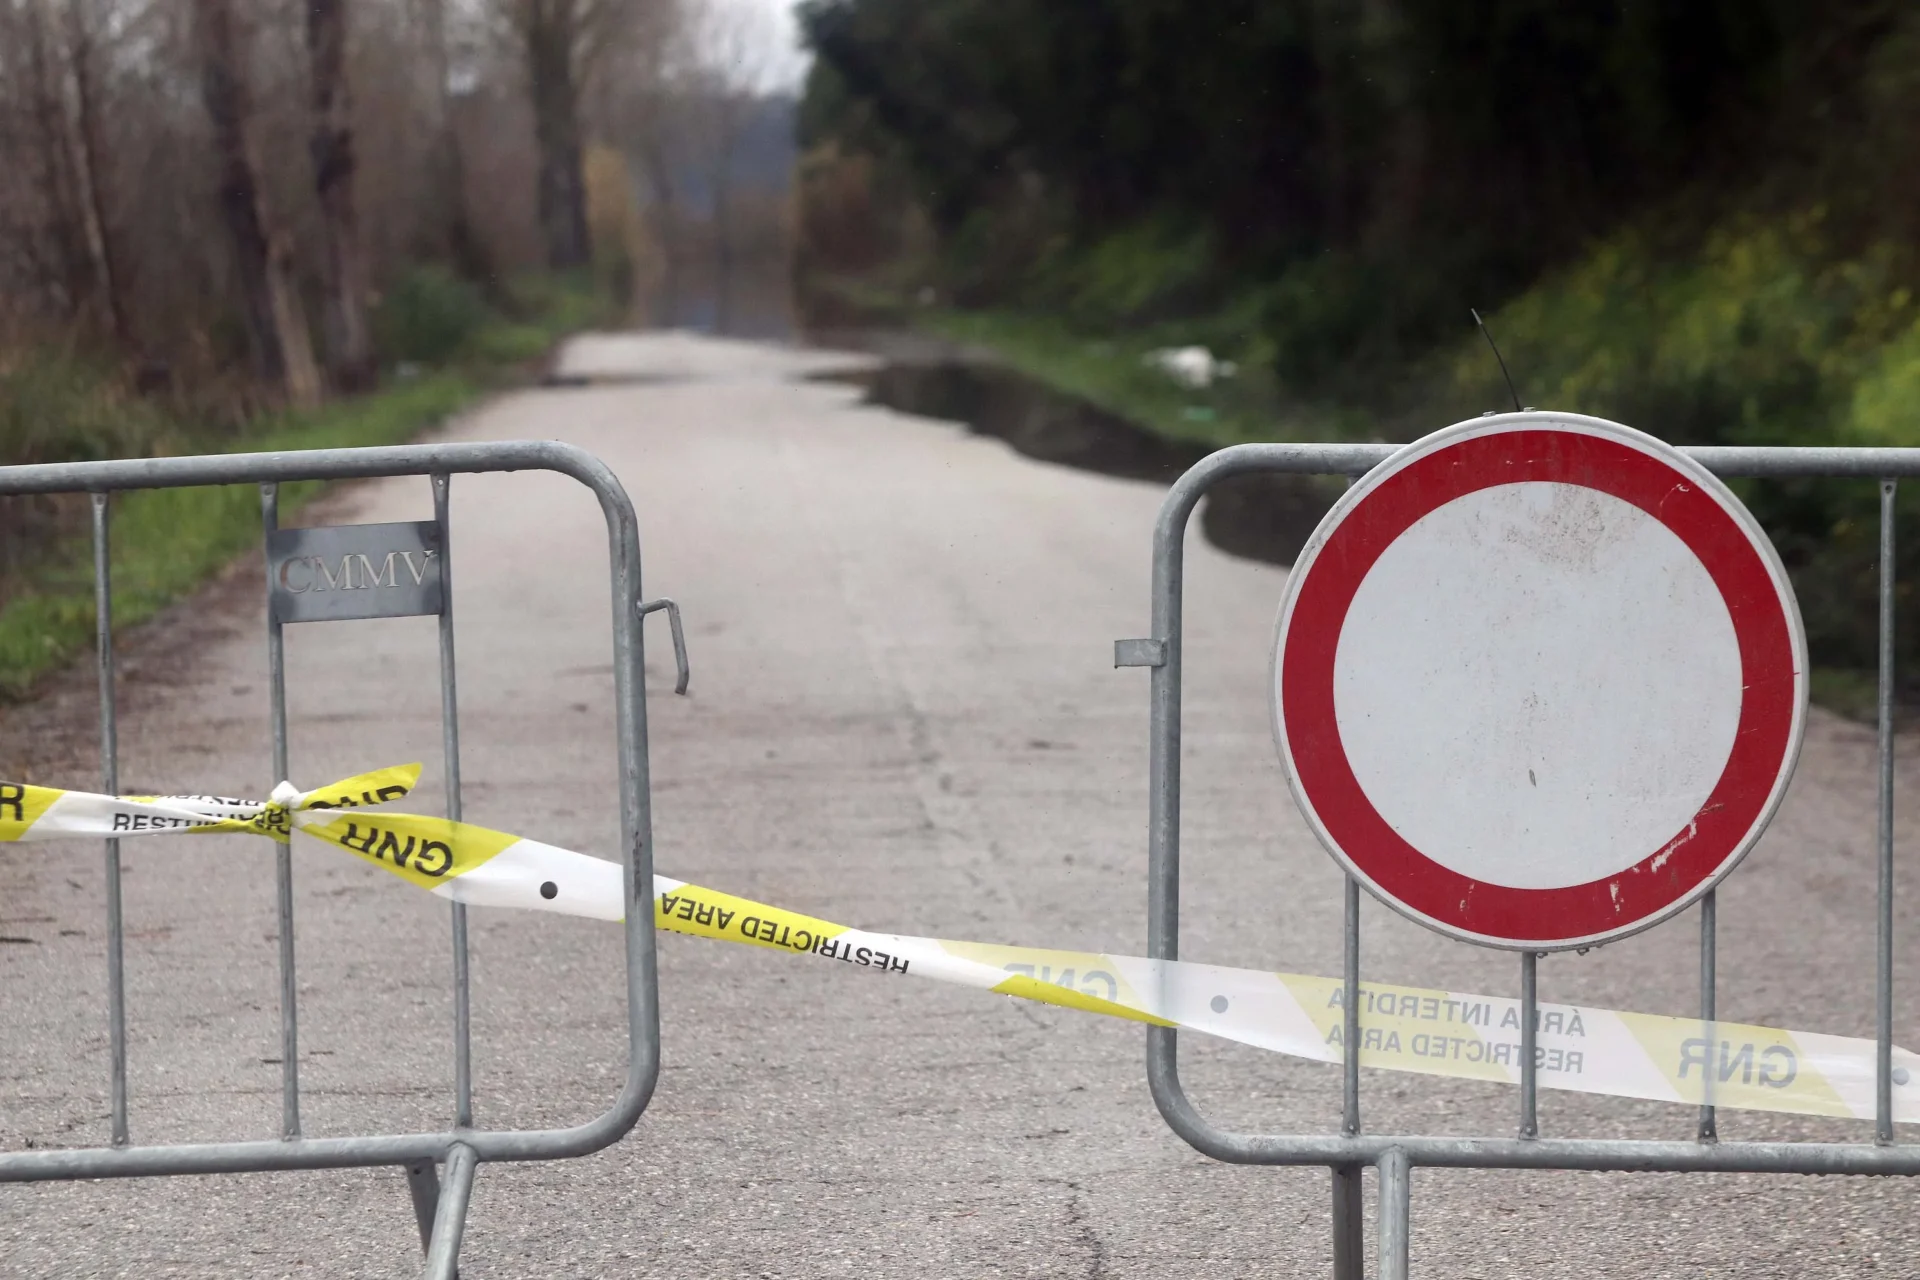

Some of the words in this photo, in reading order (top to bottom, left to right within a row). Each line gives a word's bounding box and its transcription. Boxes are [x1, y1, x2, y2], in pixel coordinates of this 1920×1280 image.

[280, 550, 438, 593] CMMV
[340, 823, 453, 877] GNR
[661, 892, 735, 930] AREA
[740, 916, 910, 974] RESTRICTED
